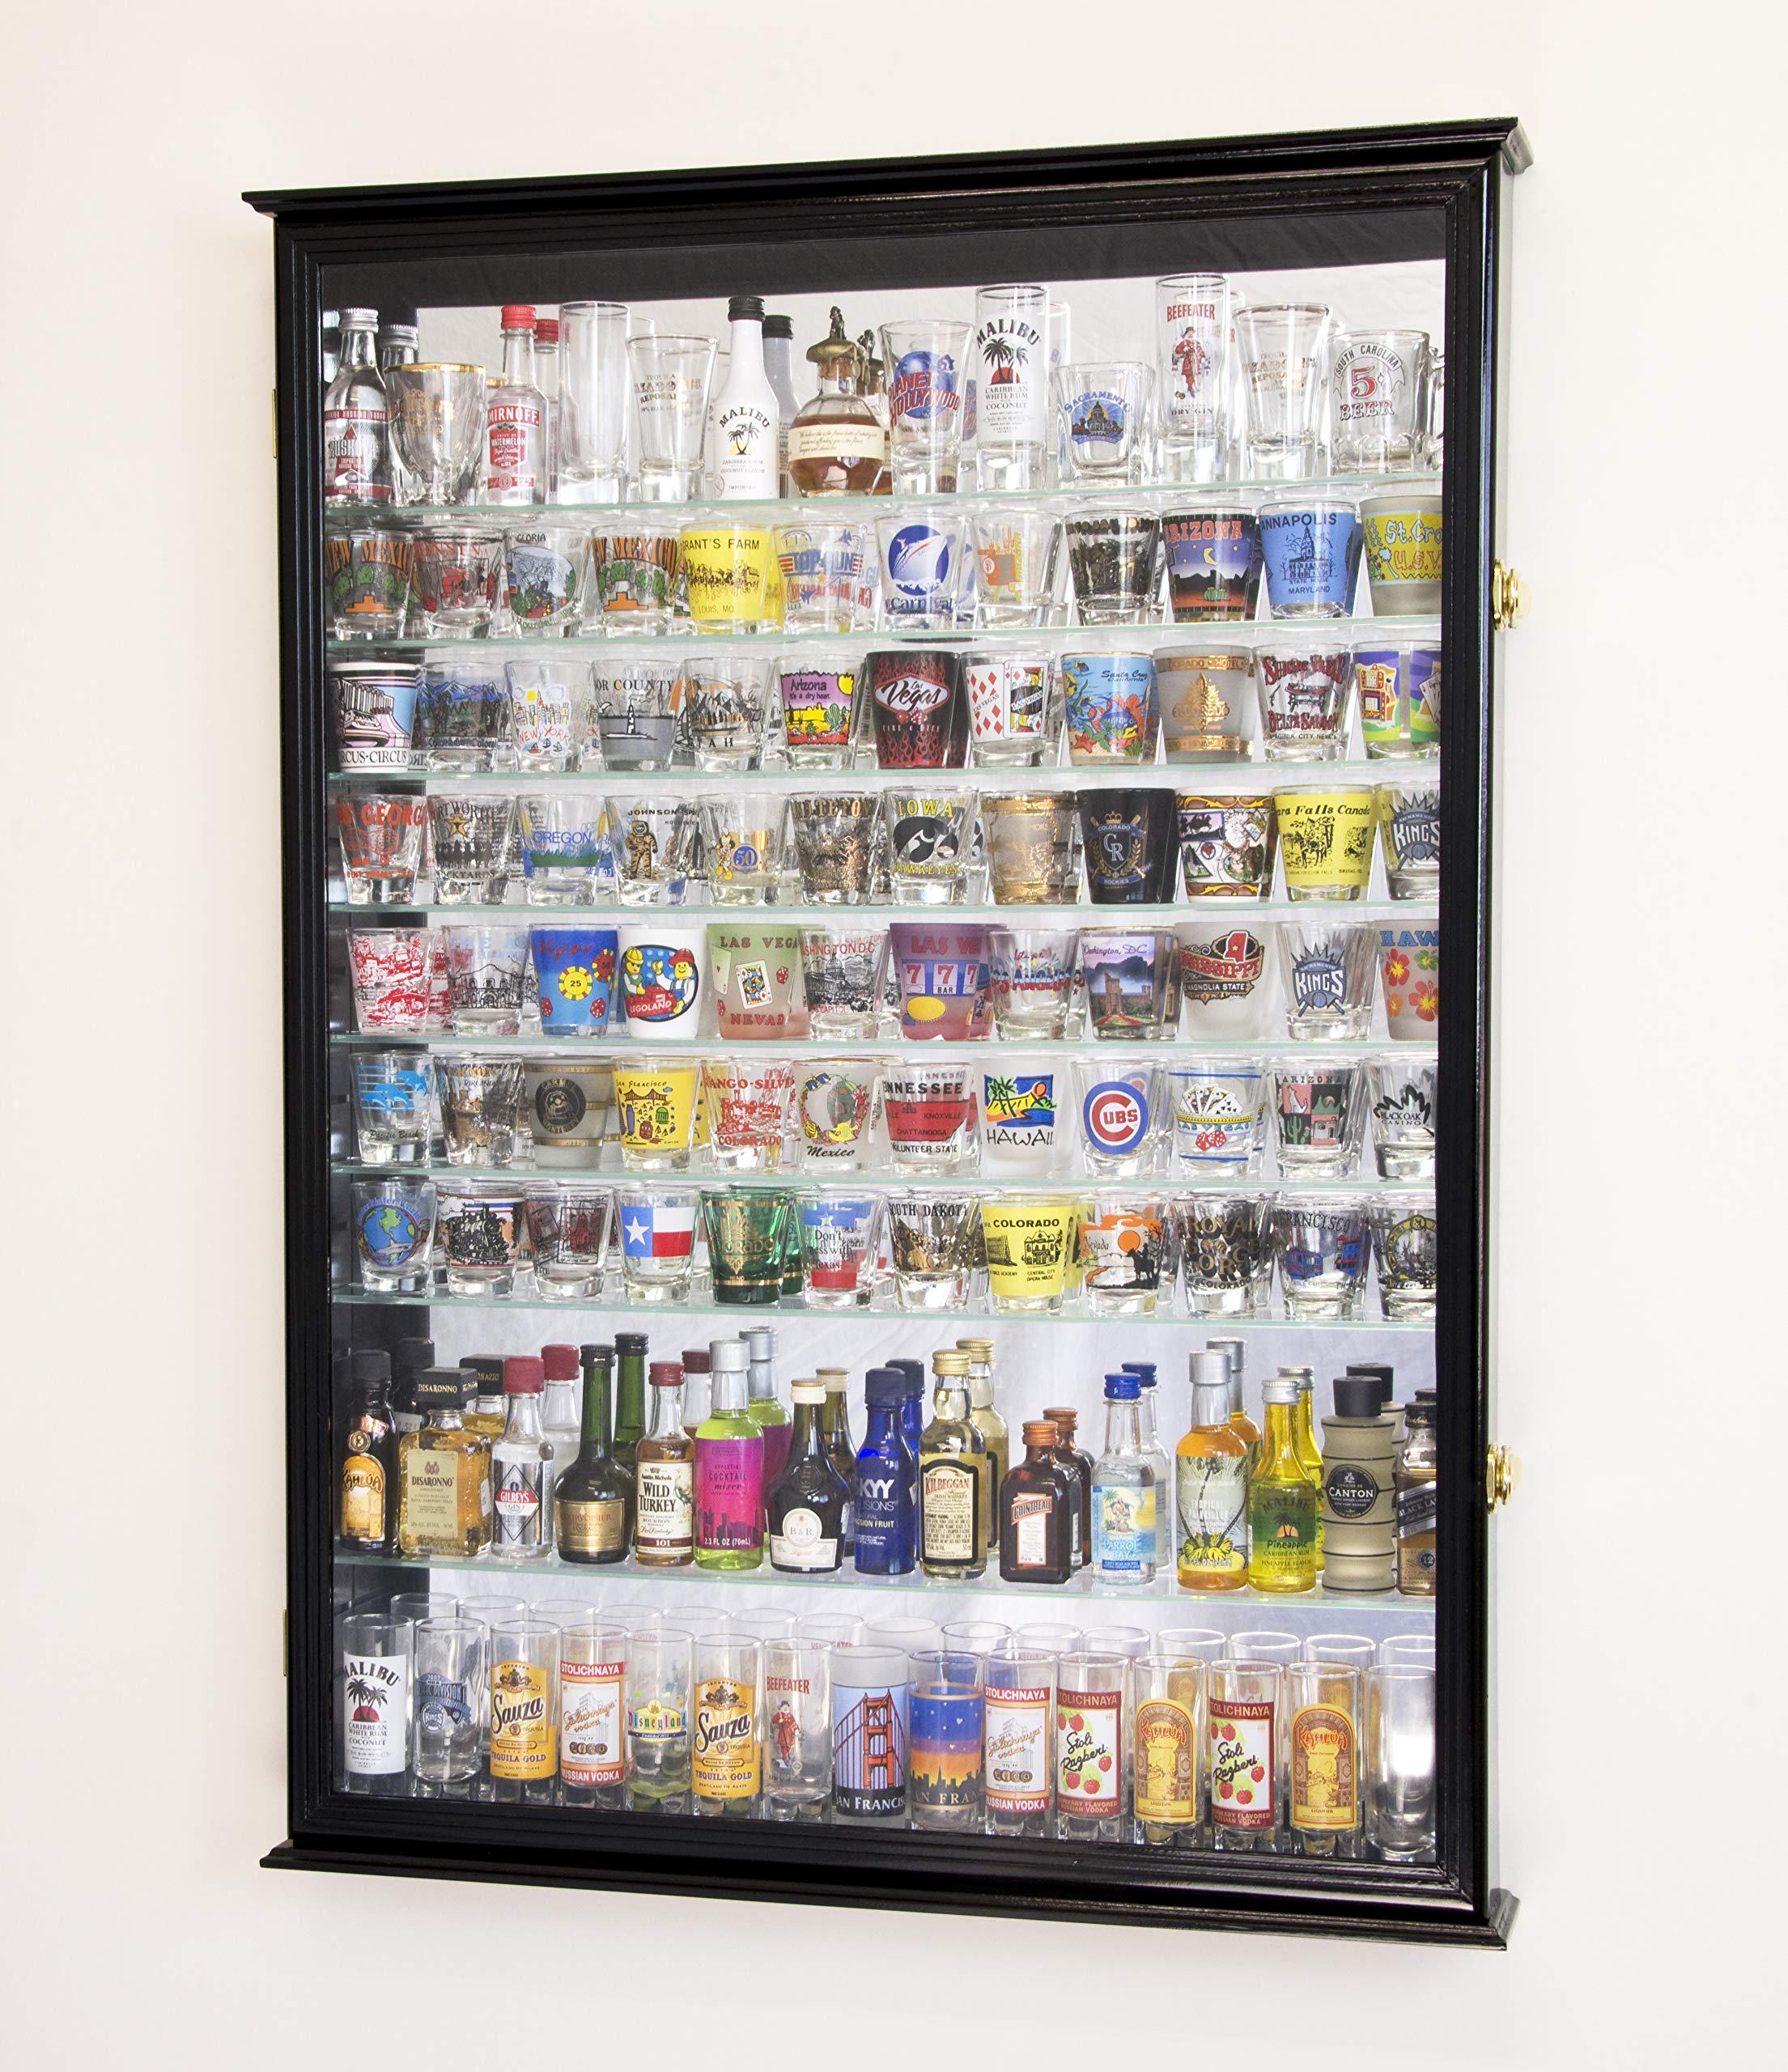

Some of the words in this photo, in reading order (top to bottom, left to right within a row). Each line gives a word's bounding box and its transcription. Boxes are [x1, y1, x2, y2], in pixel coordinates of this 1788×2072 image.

[1166, 304, 1215, 323] BEEFEATER
[976, 318, 1038, 350] MALIBU
[1336, 349, 1355, 375] SOUTH
[1361, 343, 1399, 369] CAROLINA
[986, 402, 1026, 410] COCONUT
[1063, 390, 1132, 413] SACRAMENTO
[890, 389, 961, 428] HOLLYWOOD
[1170, 408, 1192, 417] DRY
[1195, 406, 1213, 415] GIN
[1340, 401, 1395, 421] BEER
[720, 407, 770, 428] MALIBU
[491, 438, 526, 446] WATERMELON
[1260, 512, 1337, 531] ANNAPOLIS
[517, 533, 546, 542] GLORIA
[1164, 520, 1243, 542] ARIZONA
[728, 538, 760, 550] FARM
[613, 537, 678, 575] MEXICO
[1288, 586, 1331, 595] MARYLAND
[890, 596, 953, 611] Carnival
[1101, 670, 1128, 679] Santa
[1130, 670, 1149, 681] Cruz
[613, 679, 674, 691] COUNTY
[790, 679, 827, 691] Arizona
[910, 681, 923, 690] Las
[805, 692, 815, 701] dry
[881, 680, 941, 712] Vegas
[974, 701, 984, 711] LAS
[980, 693, 1000, 707] VEGAS
[1011, 700, 1026, 711] LAS
[1024, 691, 1044, 706] VEGAS
[518, 728, 538, 745] NEW
[544, 726, 568, 742] YORK
[898, 798, 953, 817] IOWA
[1295, 805, 1333, 815] Falls
[532, 831, 592, 845] OREGON
[1393, 821, 1440, 849] KINGS
[735, 848, 755, 865] 50
[894, 864, 959, 875] HAWKEYES
[720, 936, 751, 949] LAS
[911, 936, 949, 955] LAS
[906, 964, 923, 985] 7
[937, 964, 953, 985] 7
[571, 979, 581, 987] 25
[1187, 983, 1220, 991] MAGNOLIA
[1295, 970, 1346, 1000] KINGS
[937, 986, 953, 995] BAR
[629, 1000, 672, 1013] LEGOLAND
[924, 1112, 962, 1120] KNOXVILLE
[1381, 1111, 1404, 1121] BLACK
[1404, 1113, 1421, 1121] OAK
[370, 1129, 397, 1140] Pacific
[398, 1129, 420, 1139] Beach
[718, 1135, 782, 1146] COLORADO
[987, 1129, 1054, 1147] HAWAII
[807, 1144, 856, 1157] Mexico
[993, 1219, 1060, 1228] COLORADO
[815, 1229, 841, 1241] Don't
[830, 1246, 852, 1255] with
[1200, 1276, 1251, 1290] COLORADO
[418, 1384, 457, 1393] DISARONNO
[412, 1475, 453, 1488] DISARONNO
[855, 1478, 894, 1498] KYY
[925, 1477, 969, 1495] KILBEGGAN
[643, 1482, 669, 1497] WILD
[1329, 1487, 1374, 1497] CANTON
[500, 1492, 529, 1502] GILBEY'S
[639, 1495, 676, 1513] TURKEY
[1013, 1501, 1051, 1520] COINTREAU
[733, 1538, 750, 1546] (70mL)
[1103, 1539, 1138, 1551] PARROT
[1267, 1540, 1308, 1549] Pineapple
[1114, 1551, 1130, 1560] BAY
[561, 1662, 620, 1676] STOLICHNAYA
[433, 1684, 461, 1697] DIVISION
[767, 1676, 809, 1695] BEEFEATER
[986, 1686, 1045, 1700] STOLICHNAYA
[425, 1713, 442, 1722] KINGS
[491, 1694, 543, 1734] Sauza
[628, 1709, 686, 1730] Disneyland
[348, 1722, 387, 1730] CARIBBEAN
[694, 1712, 750, 1753] Sauza
[350, 1738, 386, 1746] COCONUT
[1066, 1731, 1093, 1755] Stoli
[491, 1751, 520, 1762] TEQUILA
[521, 1753, 546, 1763] GOLD
[1217, 1742, 1244, 1764] Stoli
[591, 1770, 620, 1781] VODKA
[695, 1770, 728, 1781] TEQUILA
[731, 1771, 753, 1781] GOLD
[1016, 1799, 1045, 1810] VODKA
